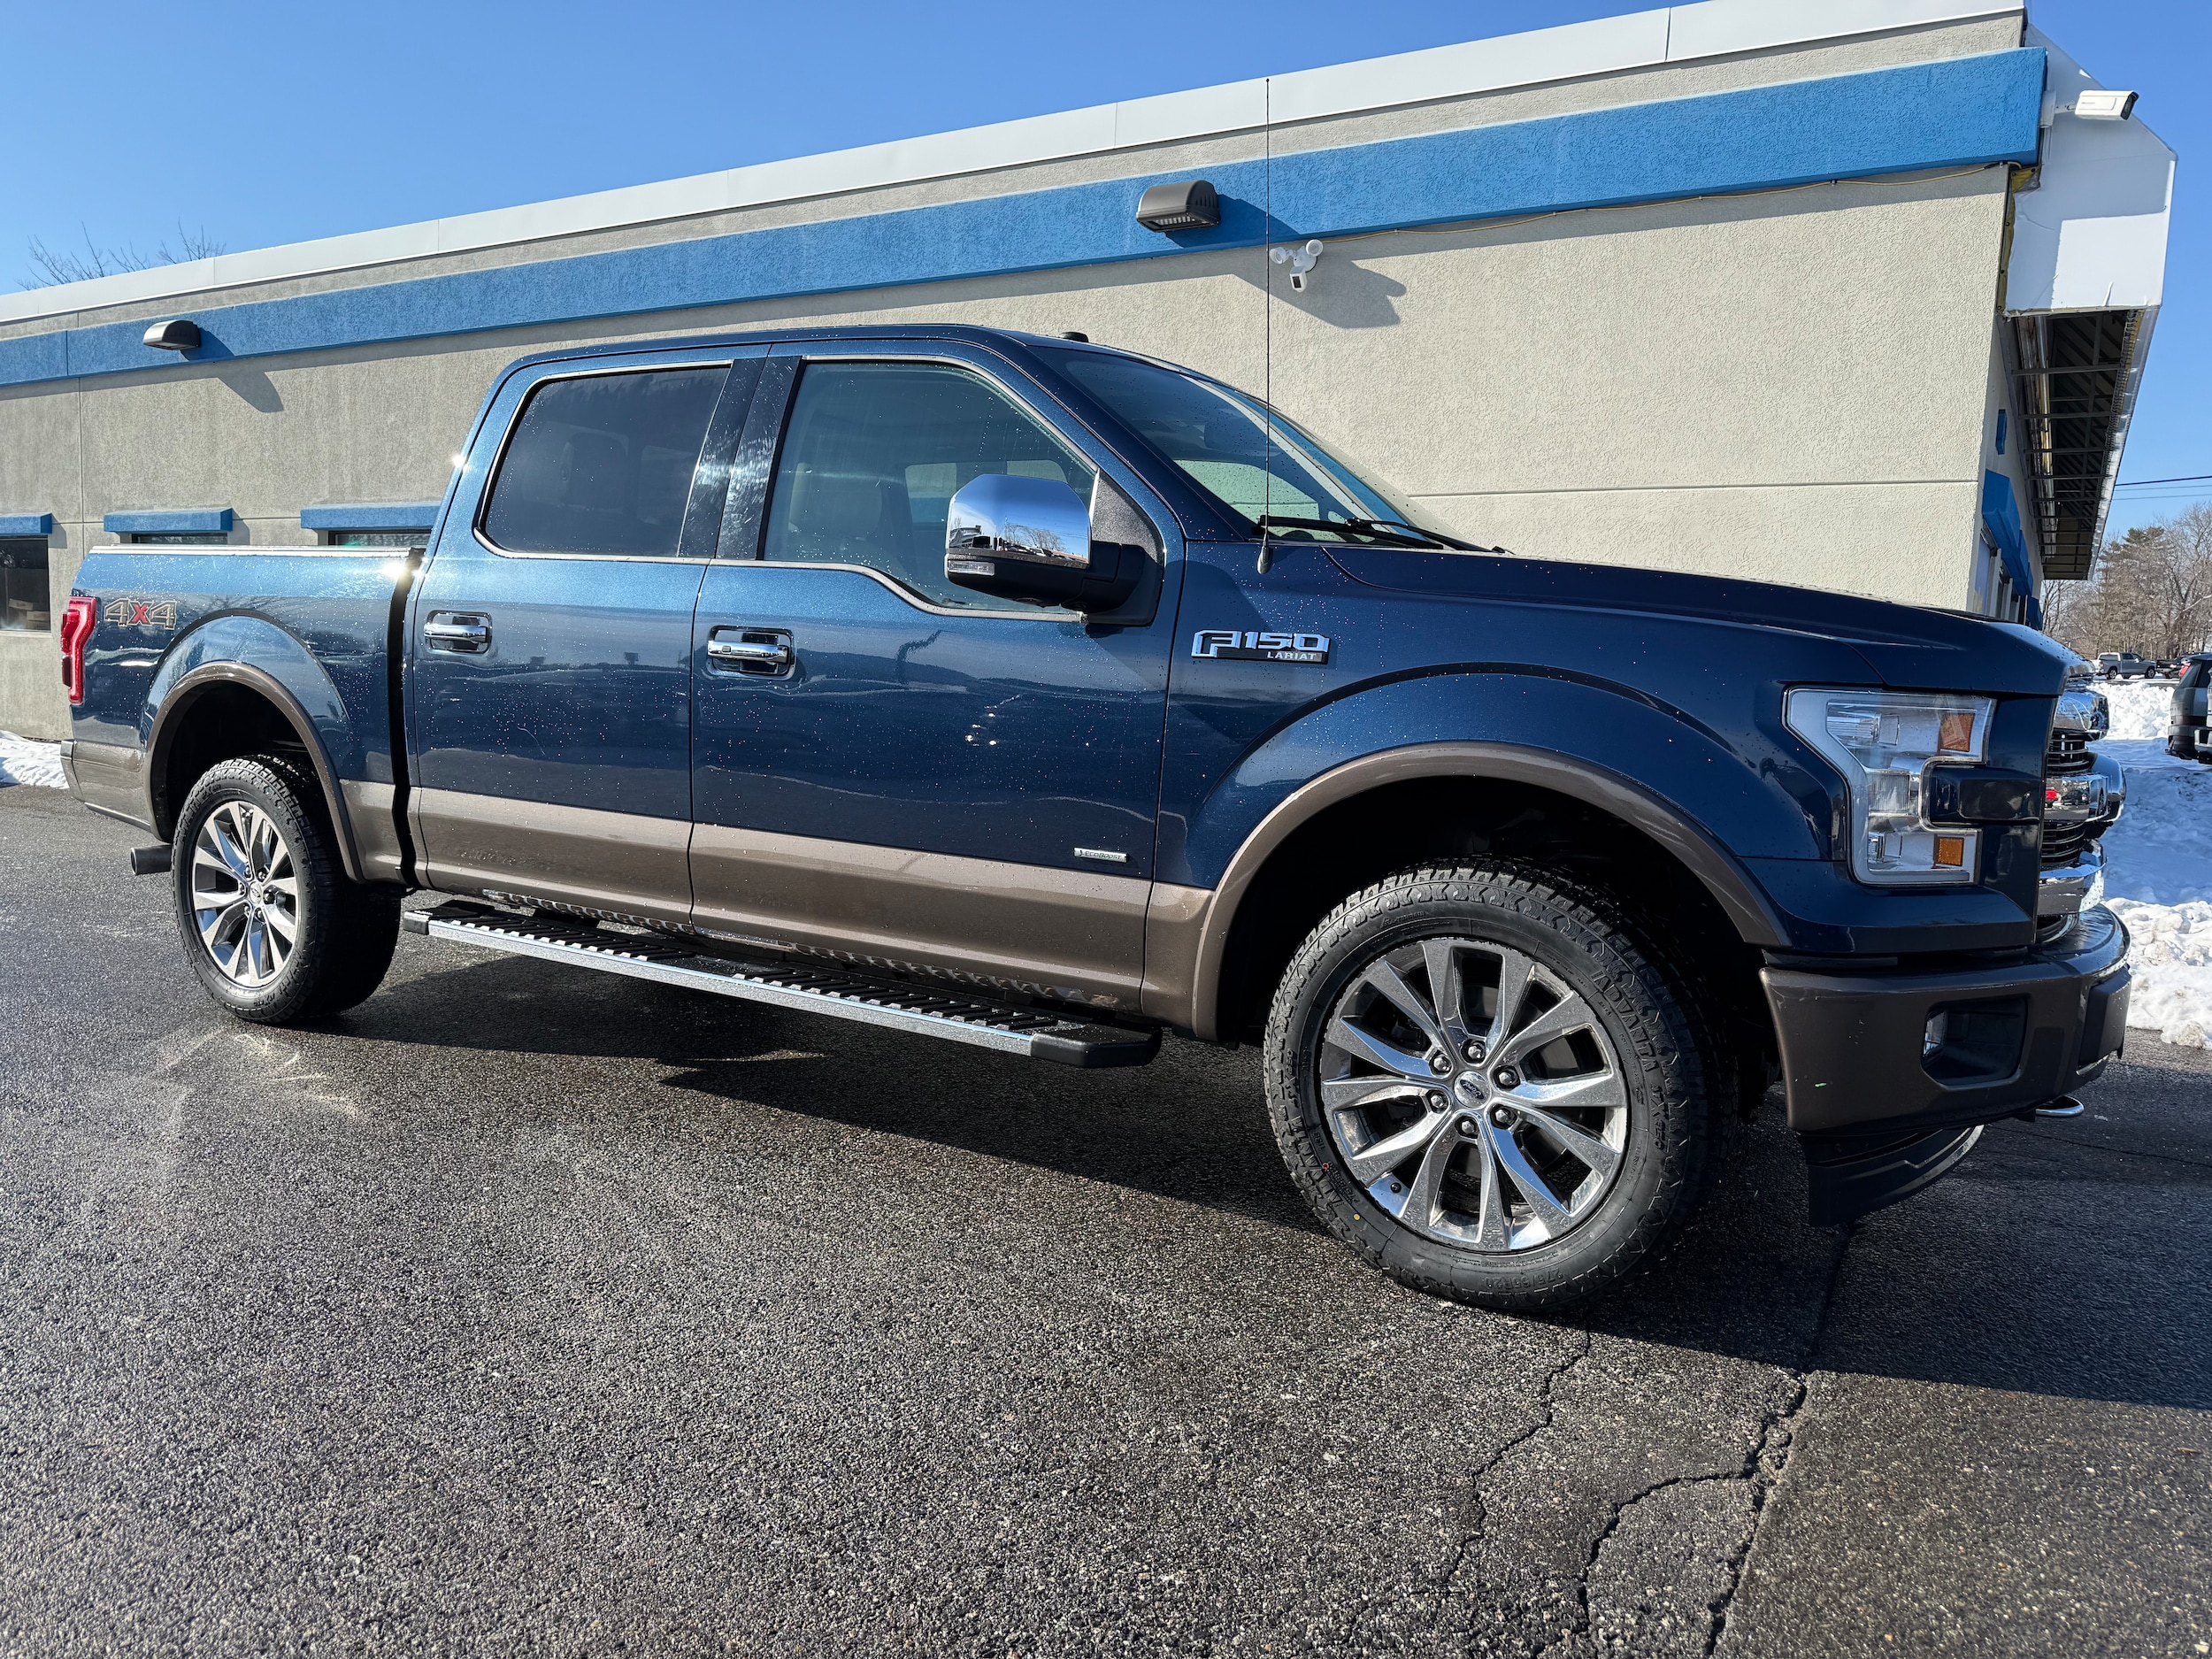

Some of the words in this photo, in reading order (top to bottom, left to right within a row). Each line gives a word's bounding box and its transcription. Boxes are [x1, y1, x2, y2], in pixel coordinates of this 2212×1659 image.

[1267, 650, 1317, 661] LARIAT
[1593, 974, 1659, 1072] ADVANTA
[1461, 1081, 1484, 1099] Ford
